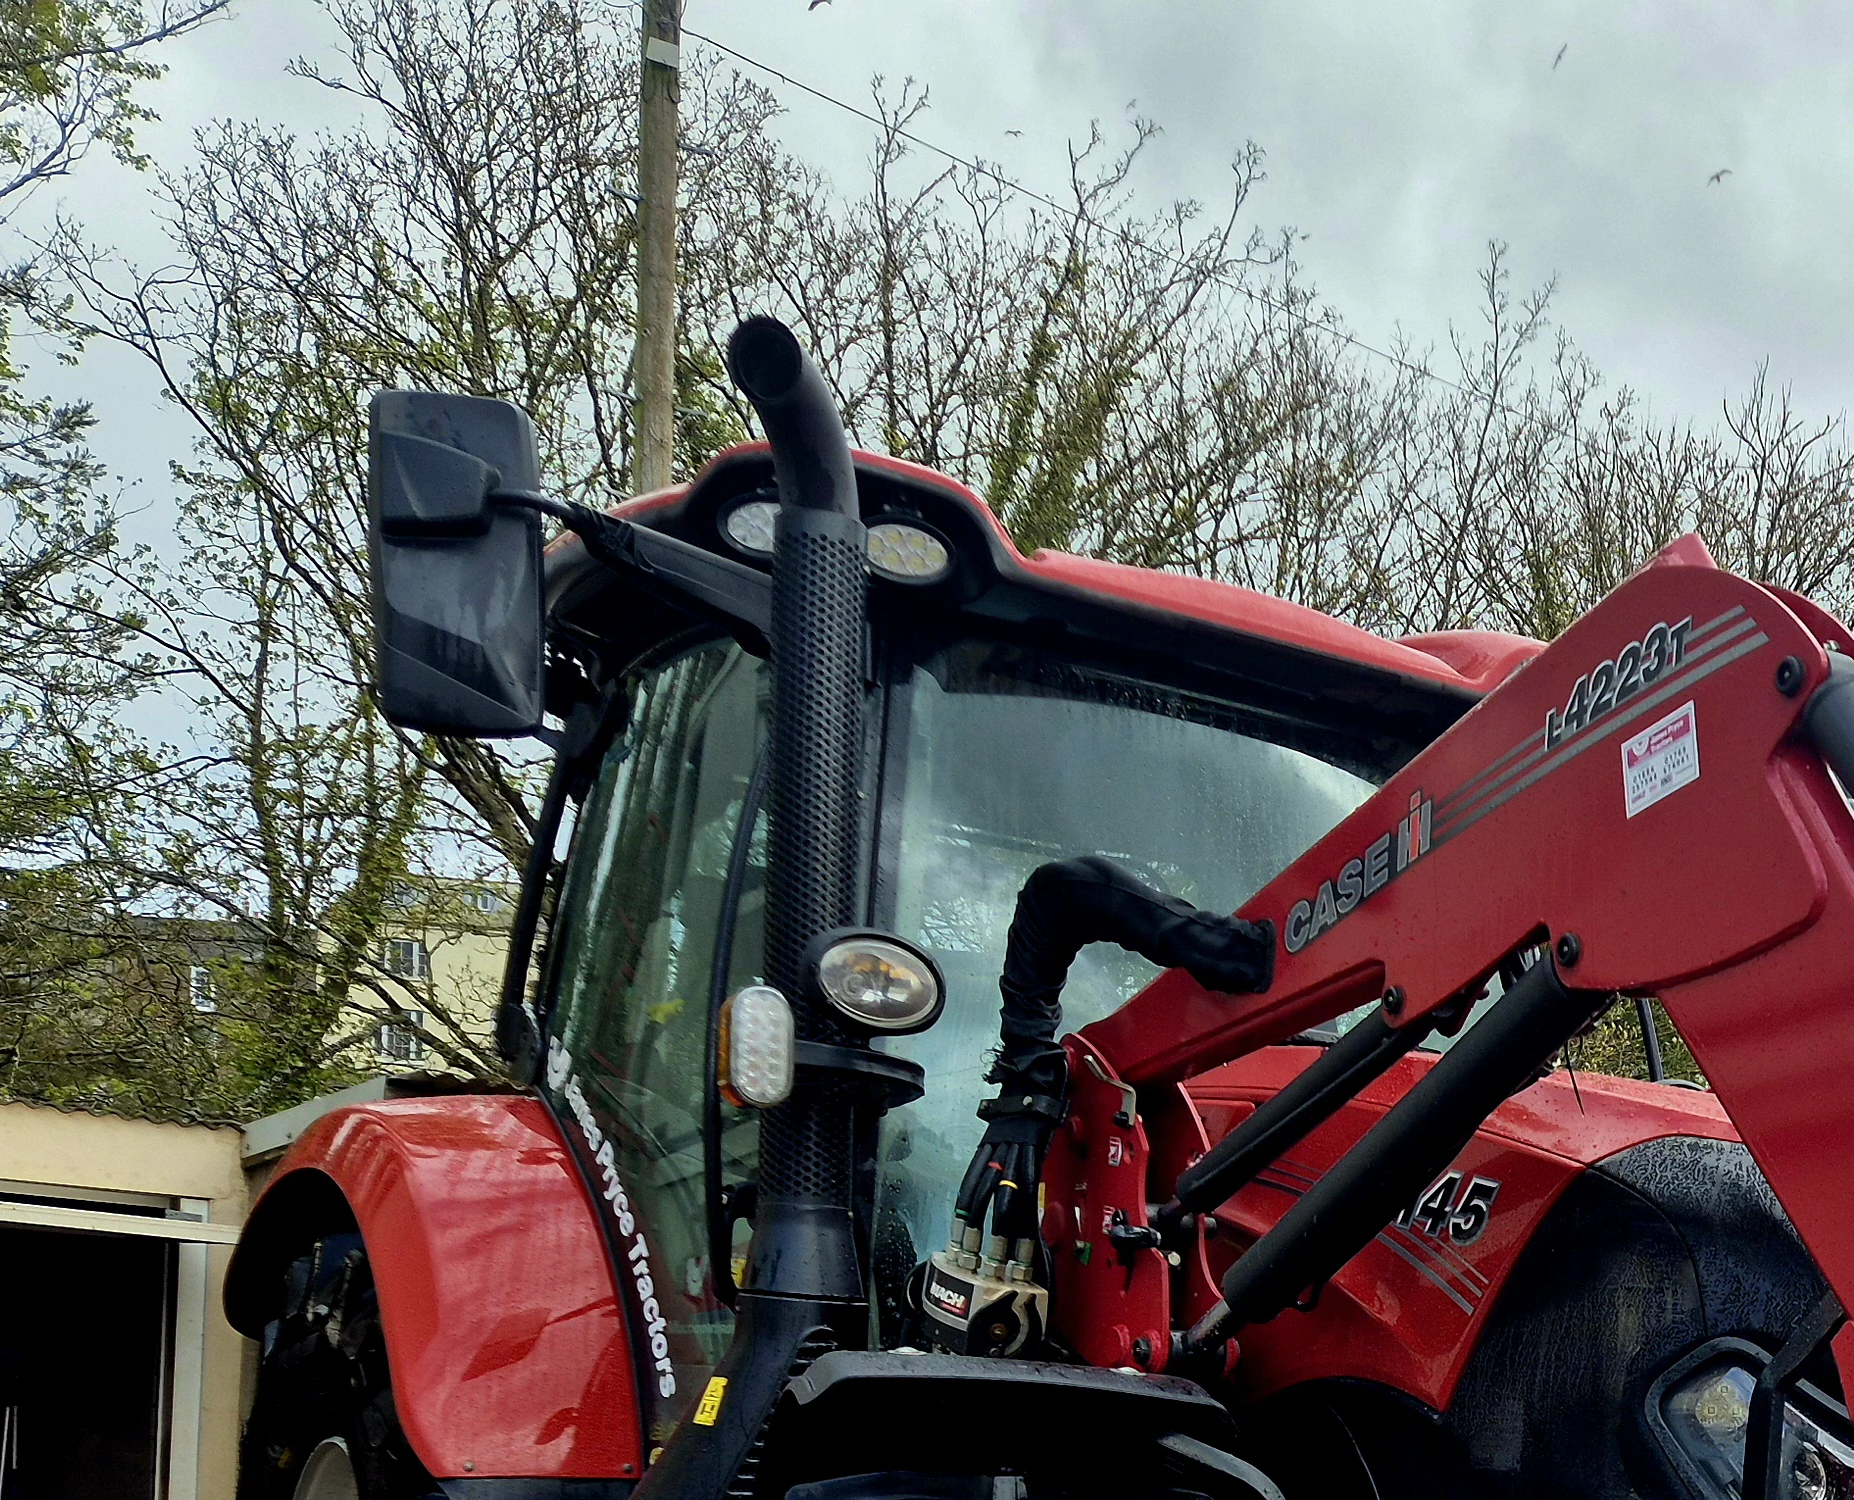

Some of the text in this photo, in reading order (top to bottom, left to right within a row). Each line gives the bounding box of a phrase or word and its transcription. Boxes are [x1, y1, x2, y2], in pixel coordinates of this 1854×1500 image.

[1545, 615, 1693, 752] L4223T
[1284, 832, 1391, 954] CASE
[595, 1139, 635, 1237] Pryce
[628, 1232, 676, 1398] Tractors
